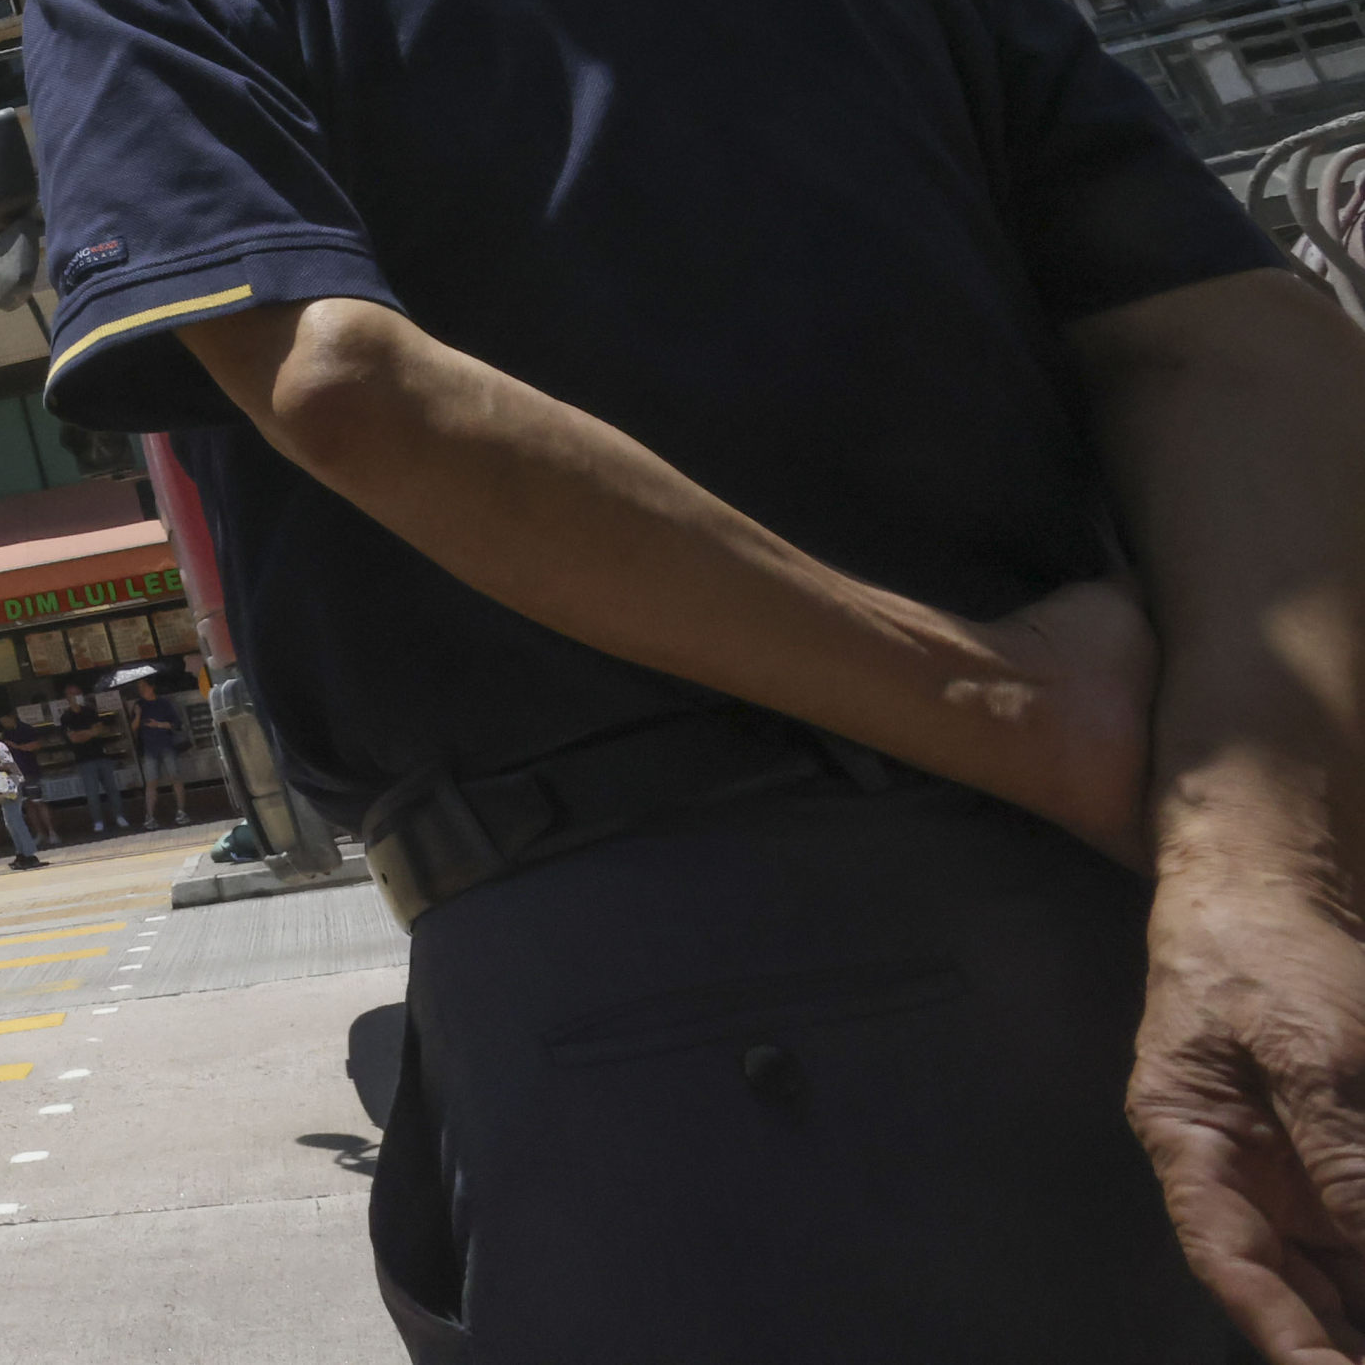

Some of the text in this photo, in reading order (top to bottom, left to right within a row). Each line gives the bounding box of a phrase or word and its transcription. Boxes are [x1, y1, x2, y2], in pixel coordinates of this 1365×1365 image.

[3, 591, 60, 620] DIM
[66, 581, 116, 608] LUI
[125, 567, 183, 598] LEE
